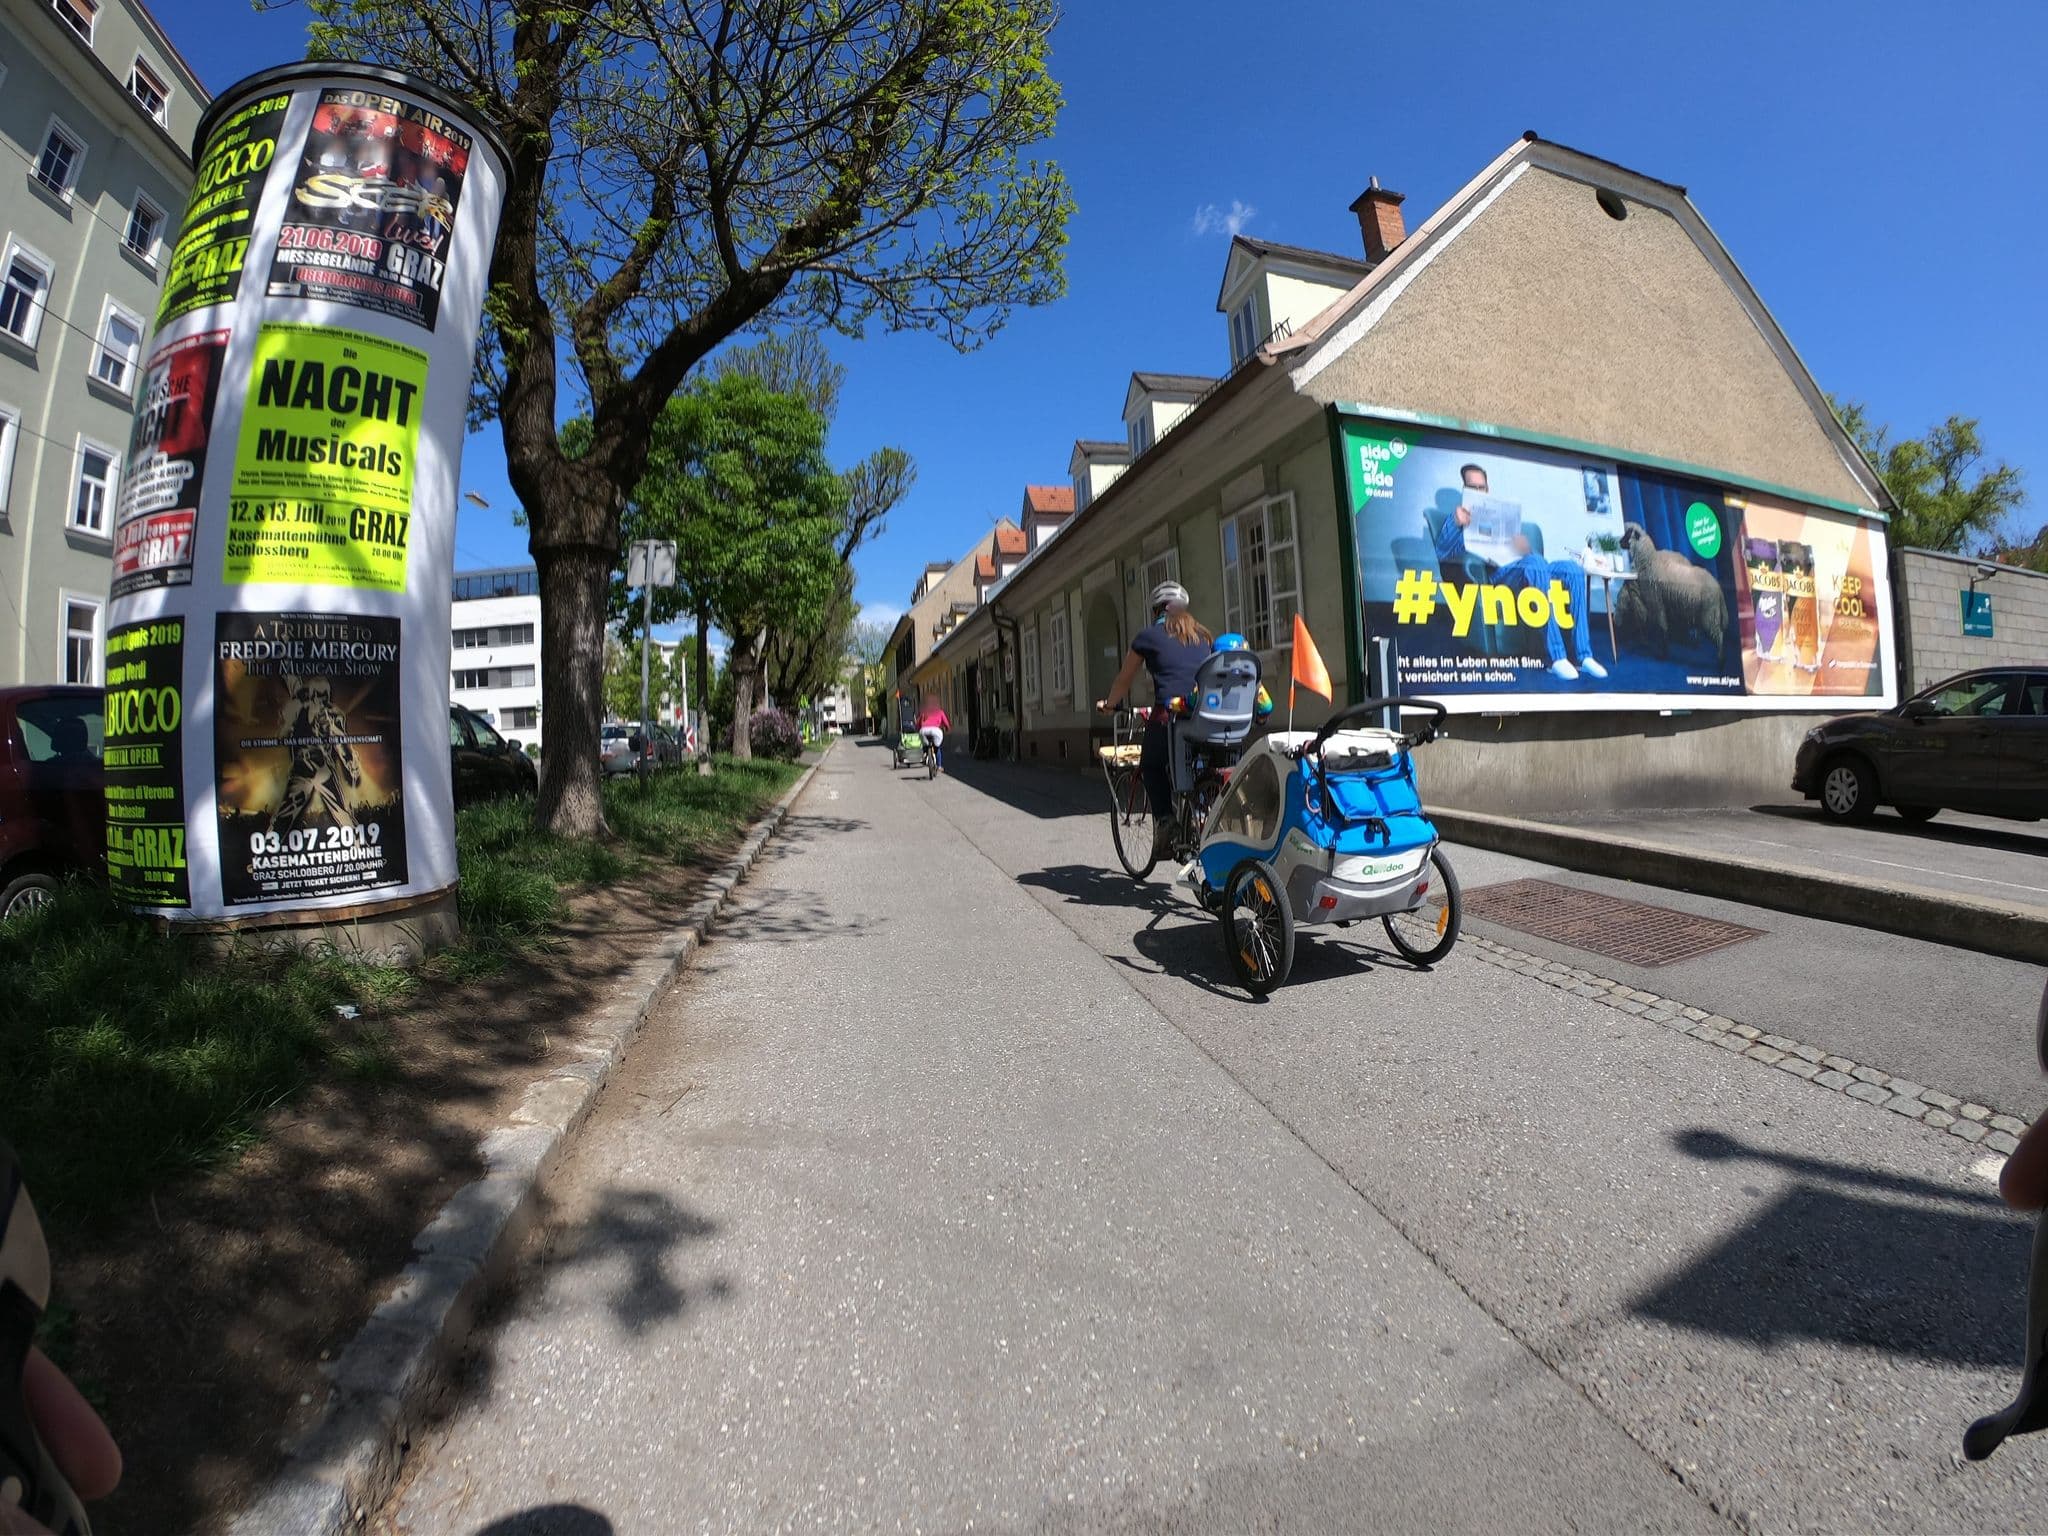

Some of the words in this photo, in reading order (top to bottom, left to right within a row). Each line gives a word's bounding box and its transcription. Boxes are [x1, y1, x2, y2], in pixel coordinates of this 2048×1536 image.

[257, 95, 289, 115] 2019
[324, 94, 348, 104] DAS
[350, 91, 407, 118] OPEN
[409, 109, 443, 133] AIR
[444, 127, 471, 150] 2019
[278, 226, 383, 261] 21.06.2019
[191, 239, 249, 283] GRAZ
[387, 243, 443, 291] GRAZ
[343, 347, 358, 360] Die
[257, 359, 418, 428] NACHT
[330, 417, 347, 429] der
[256, 428, 402, 476] Musicals
[1360, 442, 1391, 461] side
[1361, 458, 1379, 475] by
[1363, 470, 1394, 488] side
[230, 501, 251, 523] 12.
[254, 505, 265, 523] &
[269, 501, 290, 523] 13.
[295, 503, 324, 525] Juli
[350, 505, 408, 549] GRAZ
[138, 533, 190, 567] GRAZ
[228, 543, 309, 560] Schlossberg
[1751, 574, 1781, 588] JACOBS
[1785, 578, 1815, 593] JACOBS
[1832, 575, 1862, 595] KEEP
[1392, 569, 1574, 637] #ynot
[1833, 596, 1867, 617] COOL
[150, 623, 182, 646] 2019
[254, 623, 265, 638] A
[270, 620, 349, 641] TRIBUTE
[353, 626, 372, 641] TO
[219, 640, 304, 661] FREDDIE
[310, 640, 398, 662] MERCURY
[243, 660, 273, 676] THE
[279, 660, 341, 676] MUSICAL
[345, 660, 381, 676] SHOW
[1398, 655, 1410, 668] ht
[1413, 655, 1438, 668] alles
[1441, 655, 1453, 668] im
[1456, 655, 1488, 669] Leben
[1490, 656, 1519, 669] macht
[1521, 656, 1544, 669] Sinn.
[1405, 670, 1459, 683] versichert
[1461, 670, 1483, 683] sein
[1484, 669, 1516, 683] schon.
[104, 685, 181, 737] BUCCO
[130, 747, 160, 765] OPERA
[132, 827, 186, 868] GRAZ
[250, 822, 380, 855] 03.07.2019
[252, 845, 382, 870] KASEMATTENBÜHNE
[252, 868, 276, 882] GRAZ
[304, 878, 328, 888] TICKET
